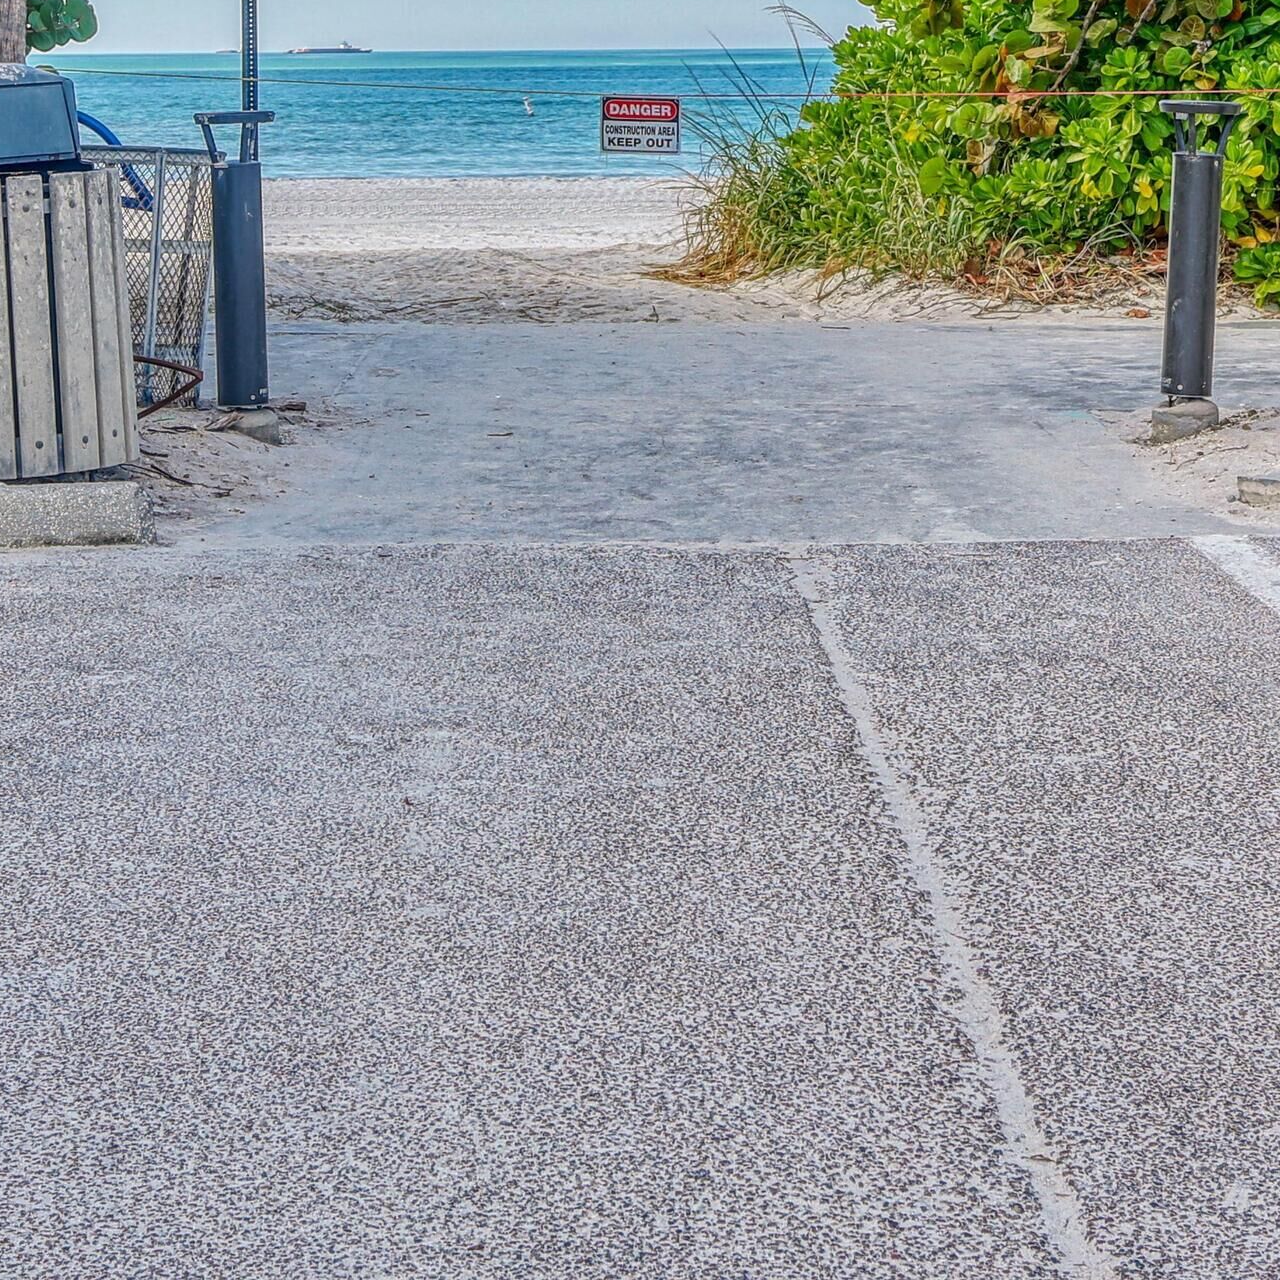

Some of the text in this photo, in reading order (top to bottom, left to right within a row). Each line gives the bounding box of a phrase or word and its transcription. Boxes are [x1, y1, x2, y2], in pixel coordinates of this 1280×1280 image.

[608, 103, 672, 116] DANGER
[606, 125, 675, 136] CONSTRUCTION AREA
[608, 137, 672, 147] KEEP OUT
